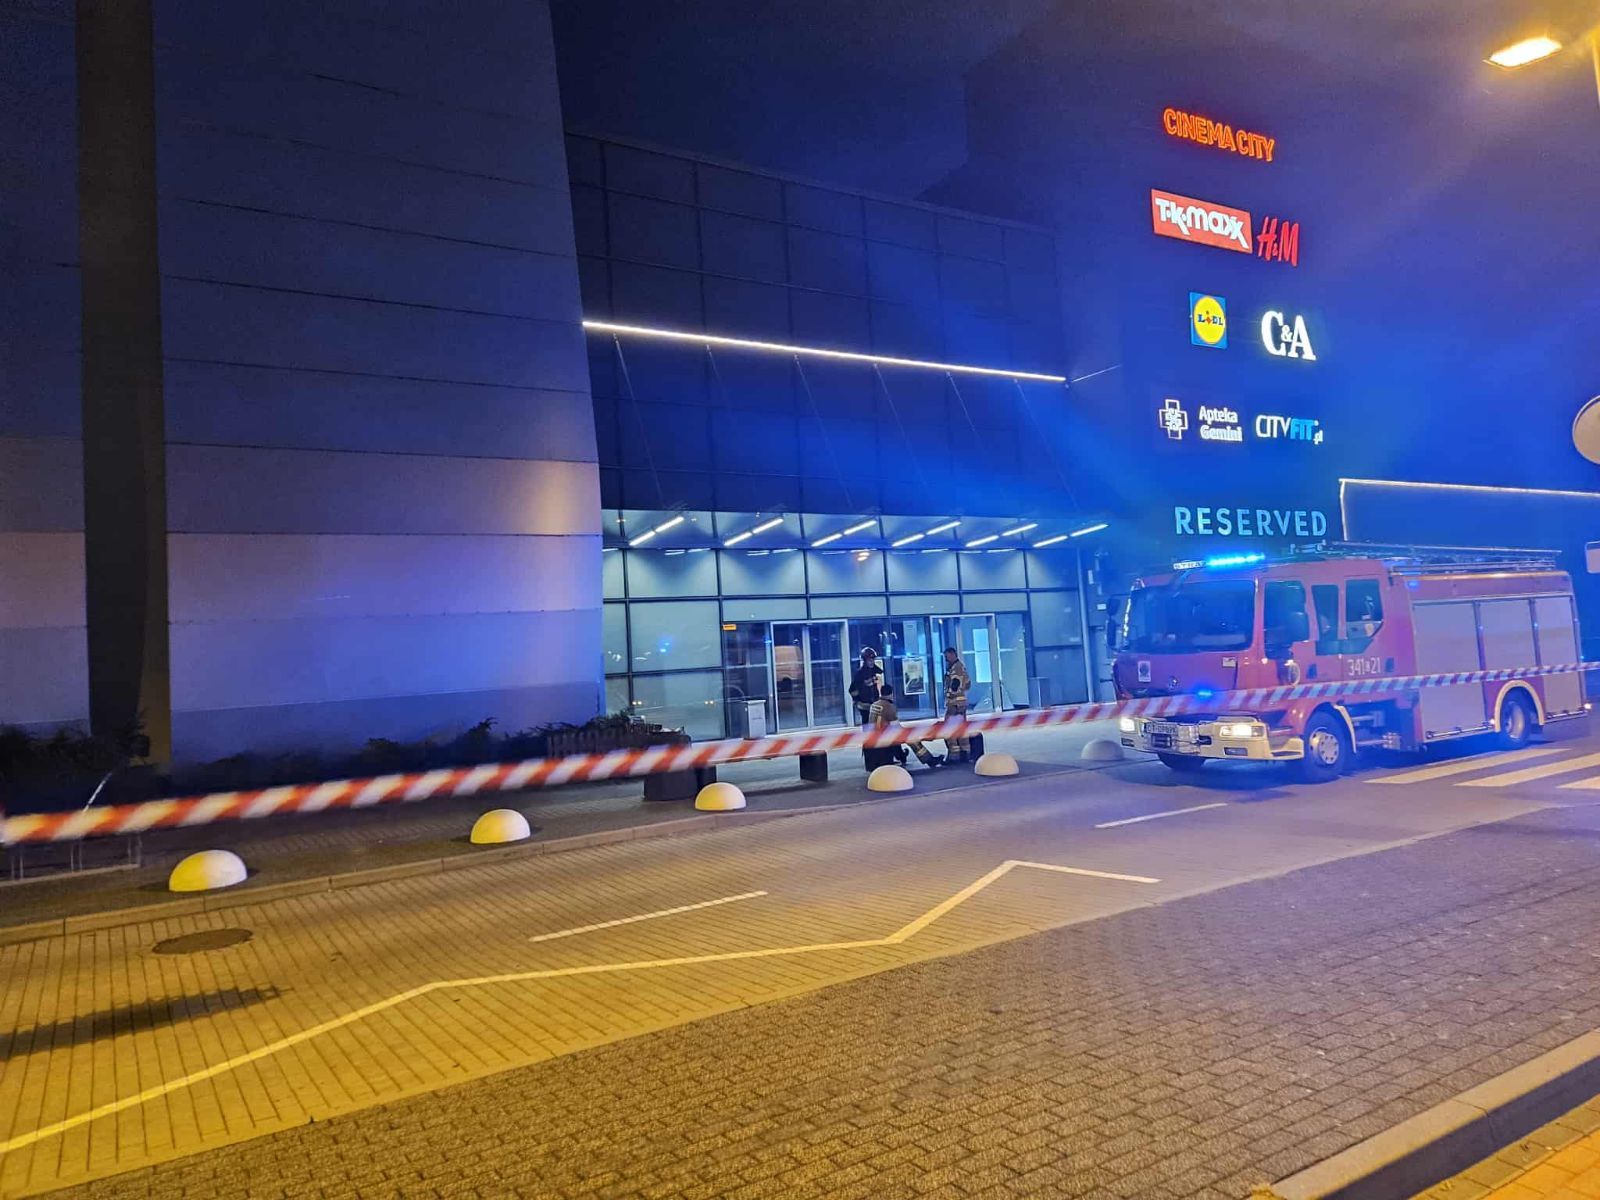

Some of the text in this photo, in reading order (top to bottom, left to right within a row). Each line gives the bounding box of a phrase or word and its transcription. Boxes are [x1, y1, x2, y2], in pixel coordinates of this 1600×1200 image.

[1163, 107, 1276, 162] CINEMA CITY
[1257, 216, 1300, 267] H&M
[1261, 310, 1317, 361] C&A
[1199, 406, 1238, 426] Apteka
[1200, 424, 1243, 442] Gemini
[1174, 506, 1327, 537] RESERVED
